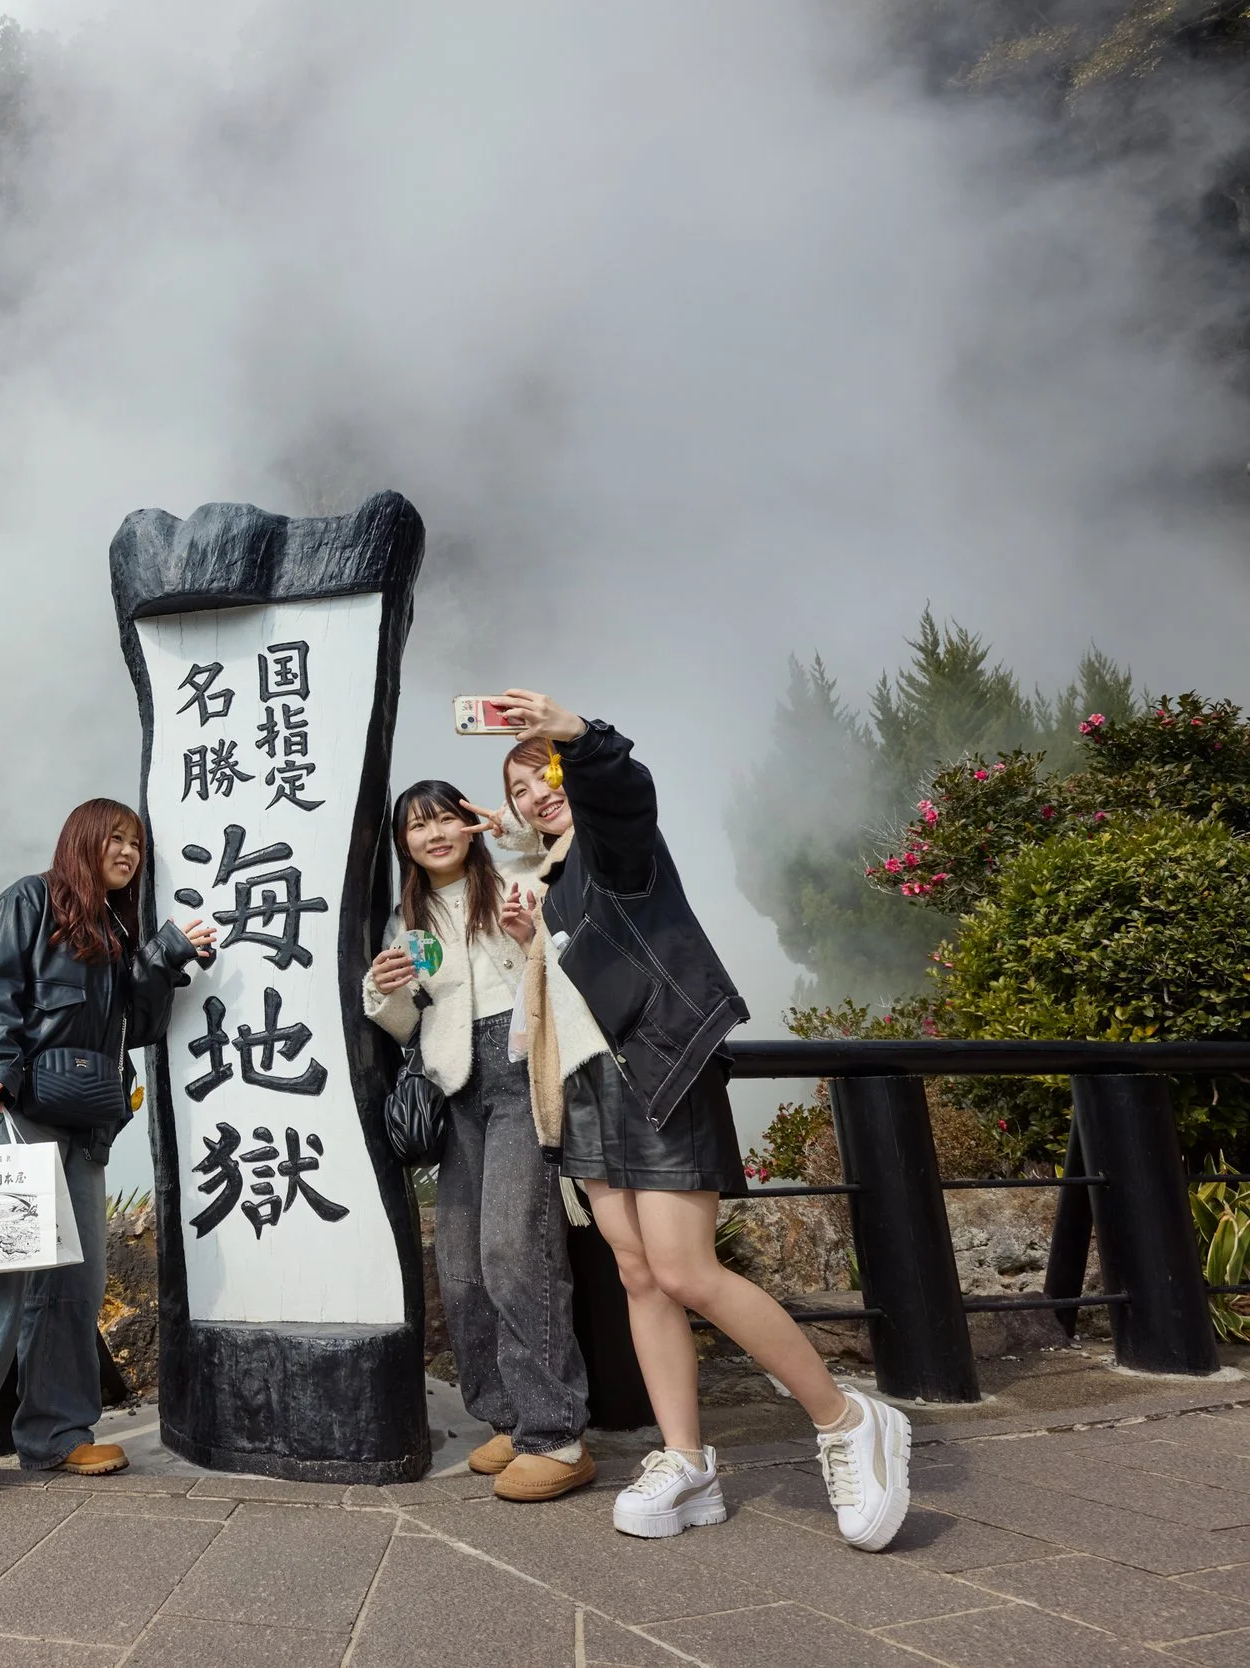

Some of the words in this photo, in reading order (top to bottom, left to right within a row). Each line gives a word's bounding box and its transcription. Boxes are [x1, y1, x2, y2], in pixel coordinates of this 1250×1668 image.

[176, 661, 256, 802] 名勝
[255, 640, 326, 812] 国指定
[174, 824, 350, 1240] 海地獄
